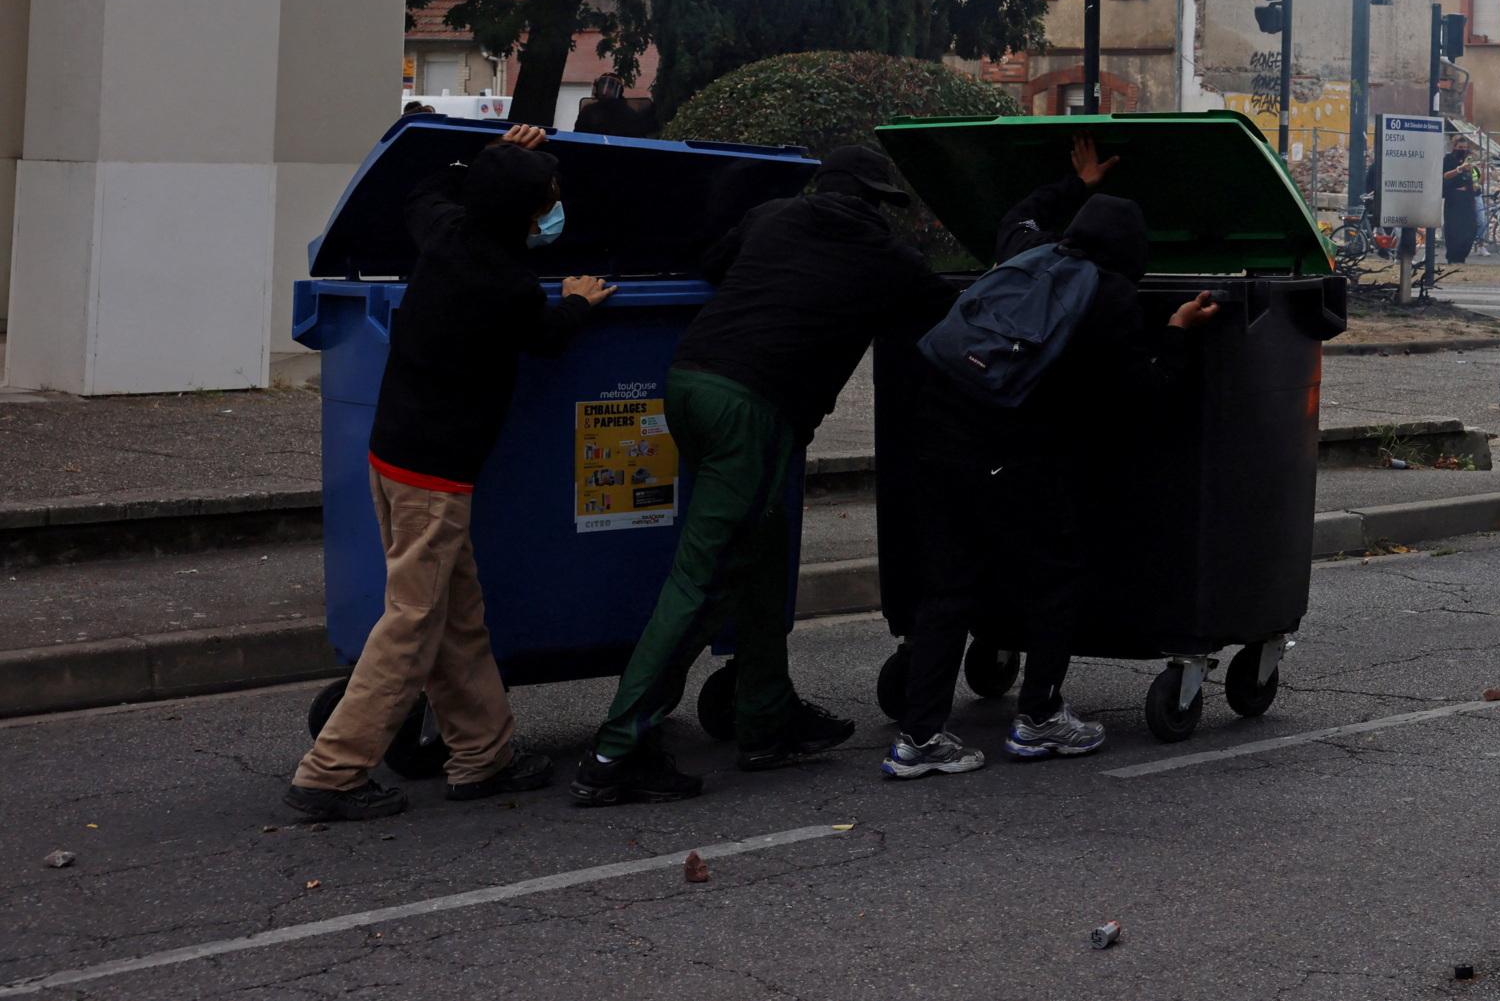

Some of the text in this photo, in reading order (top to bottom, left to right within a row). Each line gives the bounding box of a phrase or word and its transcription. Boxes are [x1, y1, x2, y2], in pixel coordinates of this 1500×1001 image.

[1390, 119, 1401, 130] 60
[1385, 133, 1406, 142] DESTIA
[617, 382, 657, 391] toulouse
[600, 390, 647, 399] métropole
[584, 403, 647, 416] EMBALLAGES
[593, 416, 634, 429] PAPIERS
